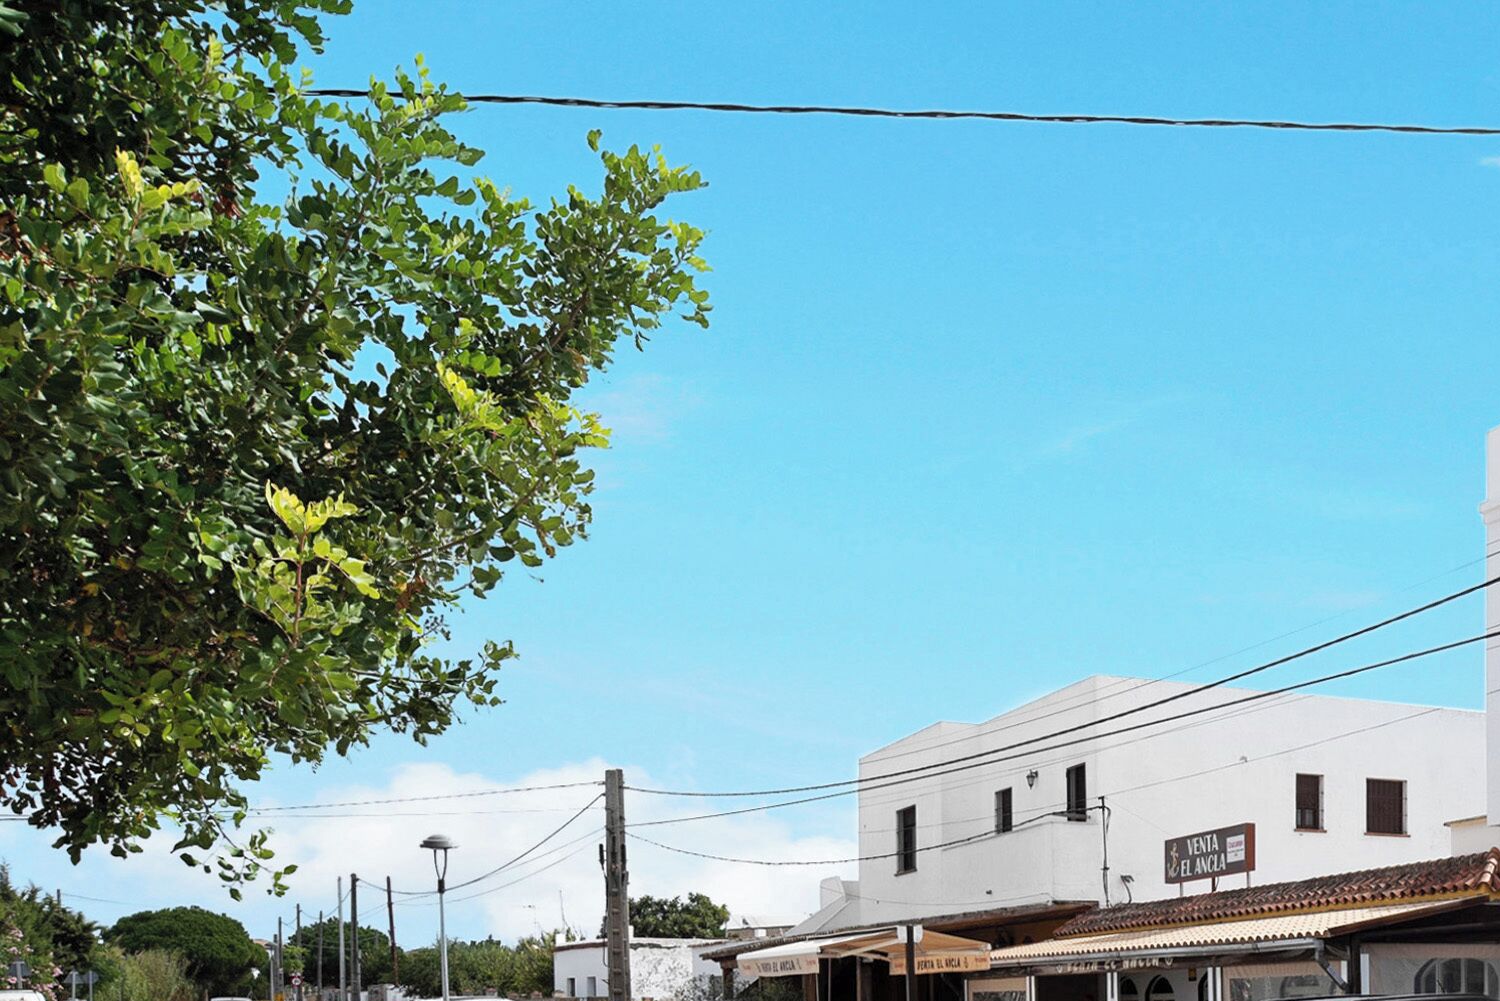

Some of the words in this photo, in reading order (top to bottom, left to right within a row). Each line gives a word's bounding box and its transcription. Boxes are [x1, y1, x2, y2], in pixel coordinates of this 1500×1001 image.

[1187, 833, 1219, 856] VENTA
[1180, 859, 1193, 877] EL
[1194, 852, 1226, 875] ANCLA
[936, 958, 944, 969] EL
[945, 957, 961, 968] ANCLA
